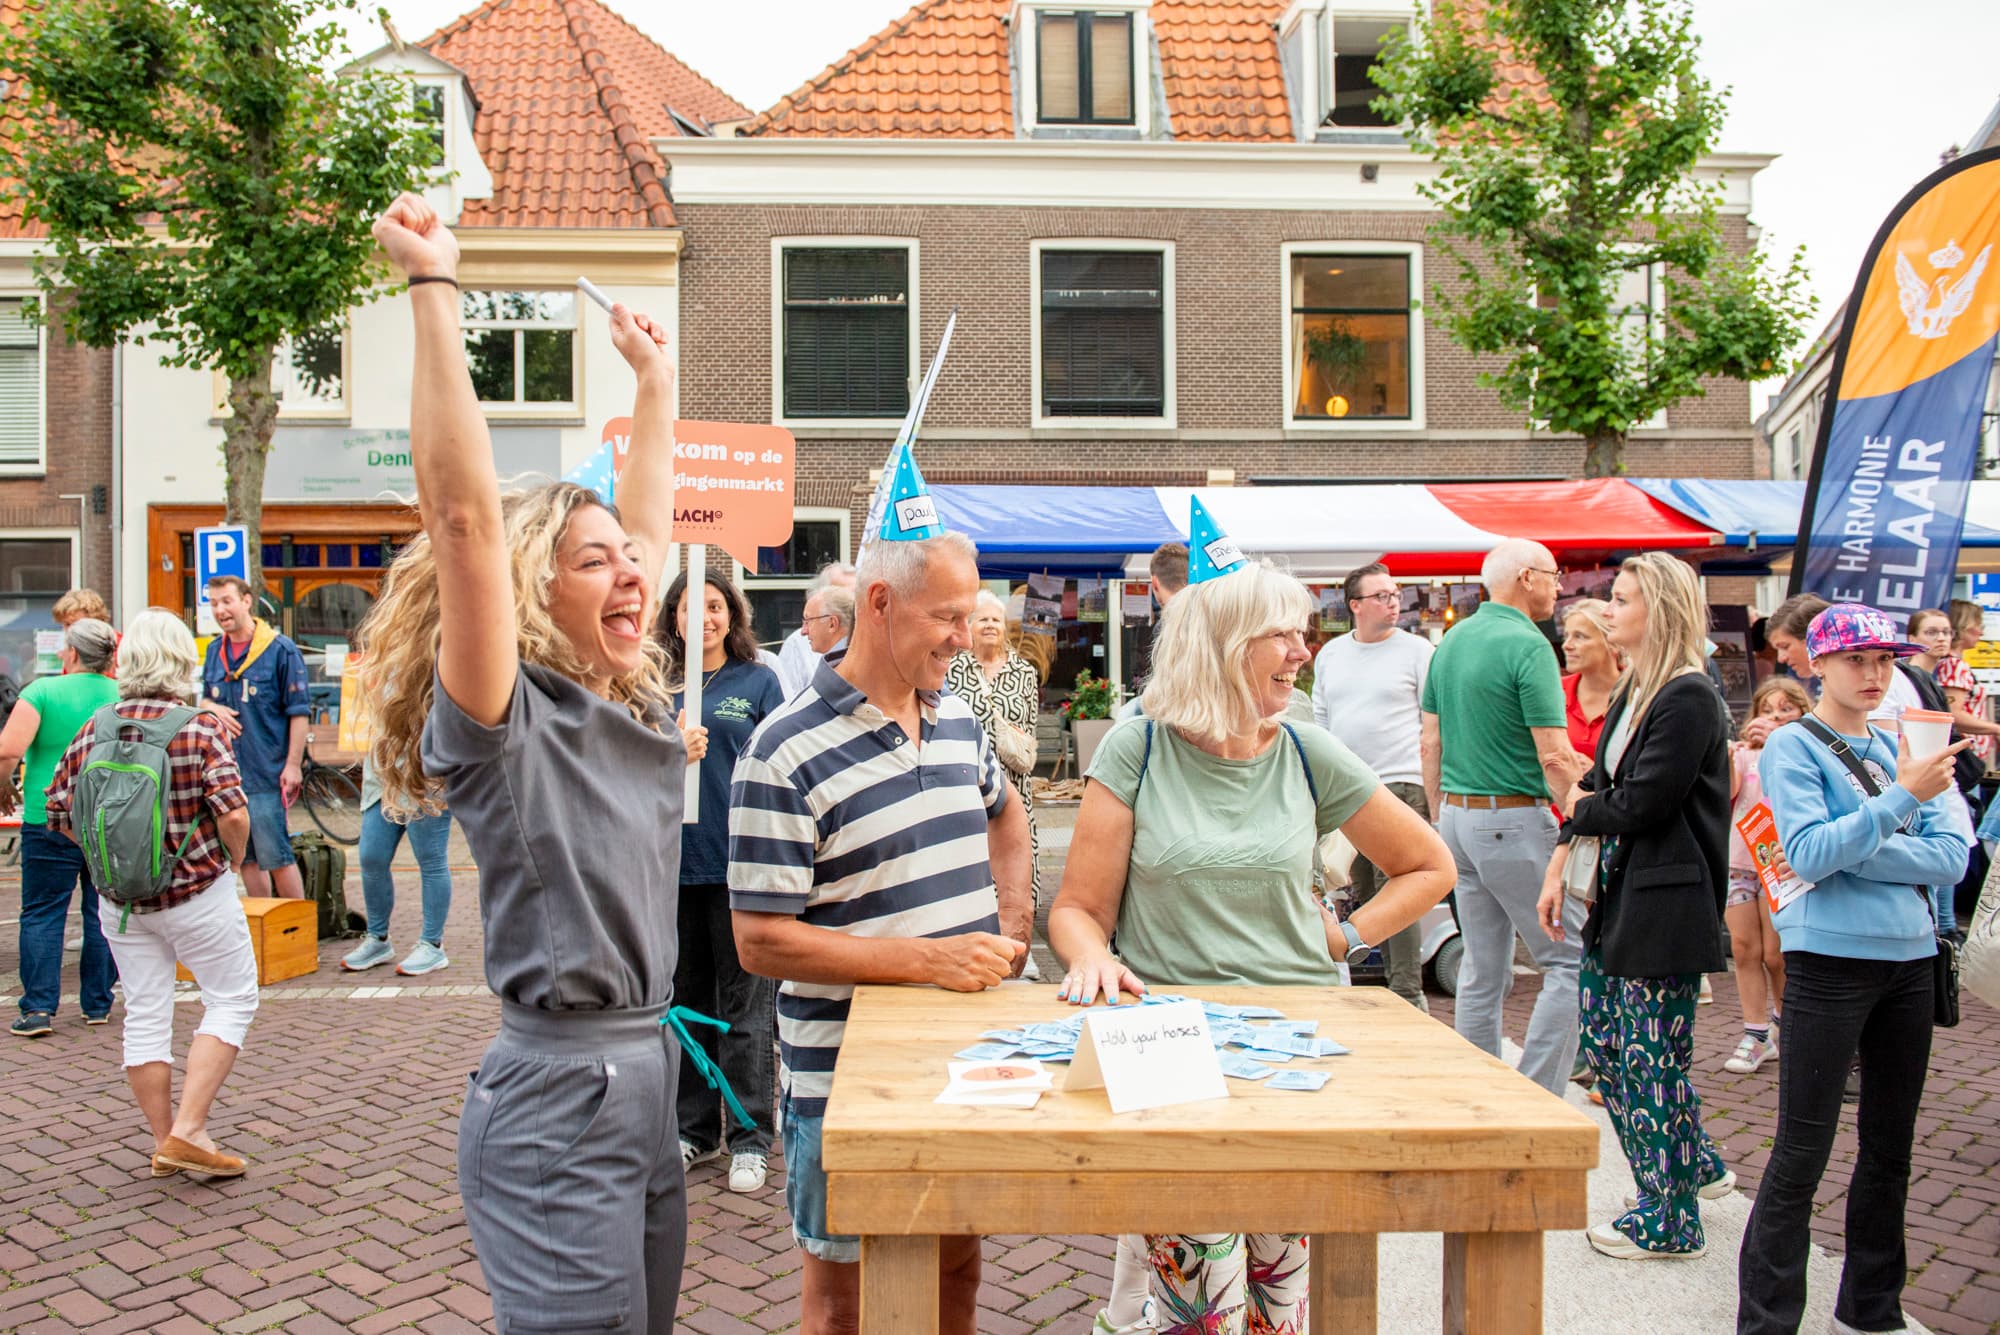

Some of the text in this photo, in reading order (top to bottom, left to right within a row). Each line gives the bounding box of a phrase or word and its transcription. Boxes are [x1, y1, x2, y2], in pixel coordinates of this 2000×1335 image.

[733, 450, 755, 465] op
[761, 449, 783, 464] de
[1835, 434, 1892, 572] HARMONIE
[207, 534, 237, 574] P
[1877, 438, 1946, 640] ELAAR
[1132, 1031, 1158, 1055] your
